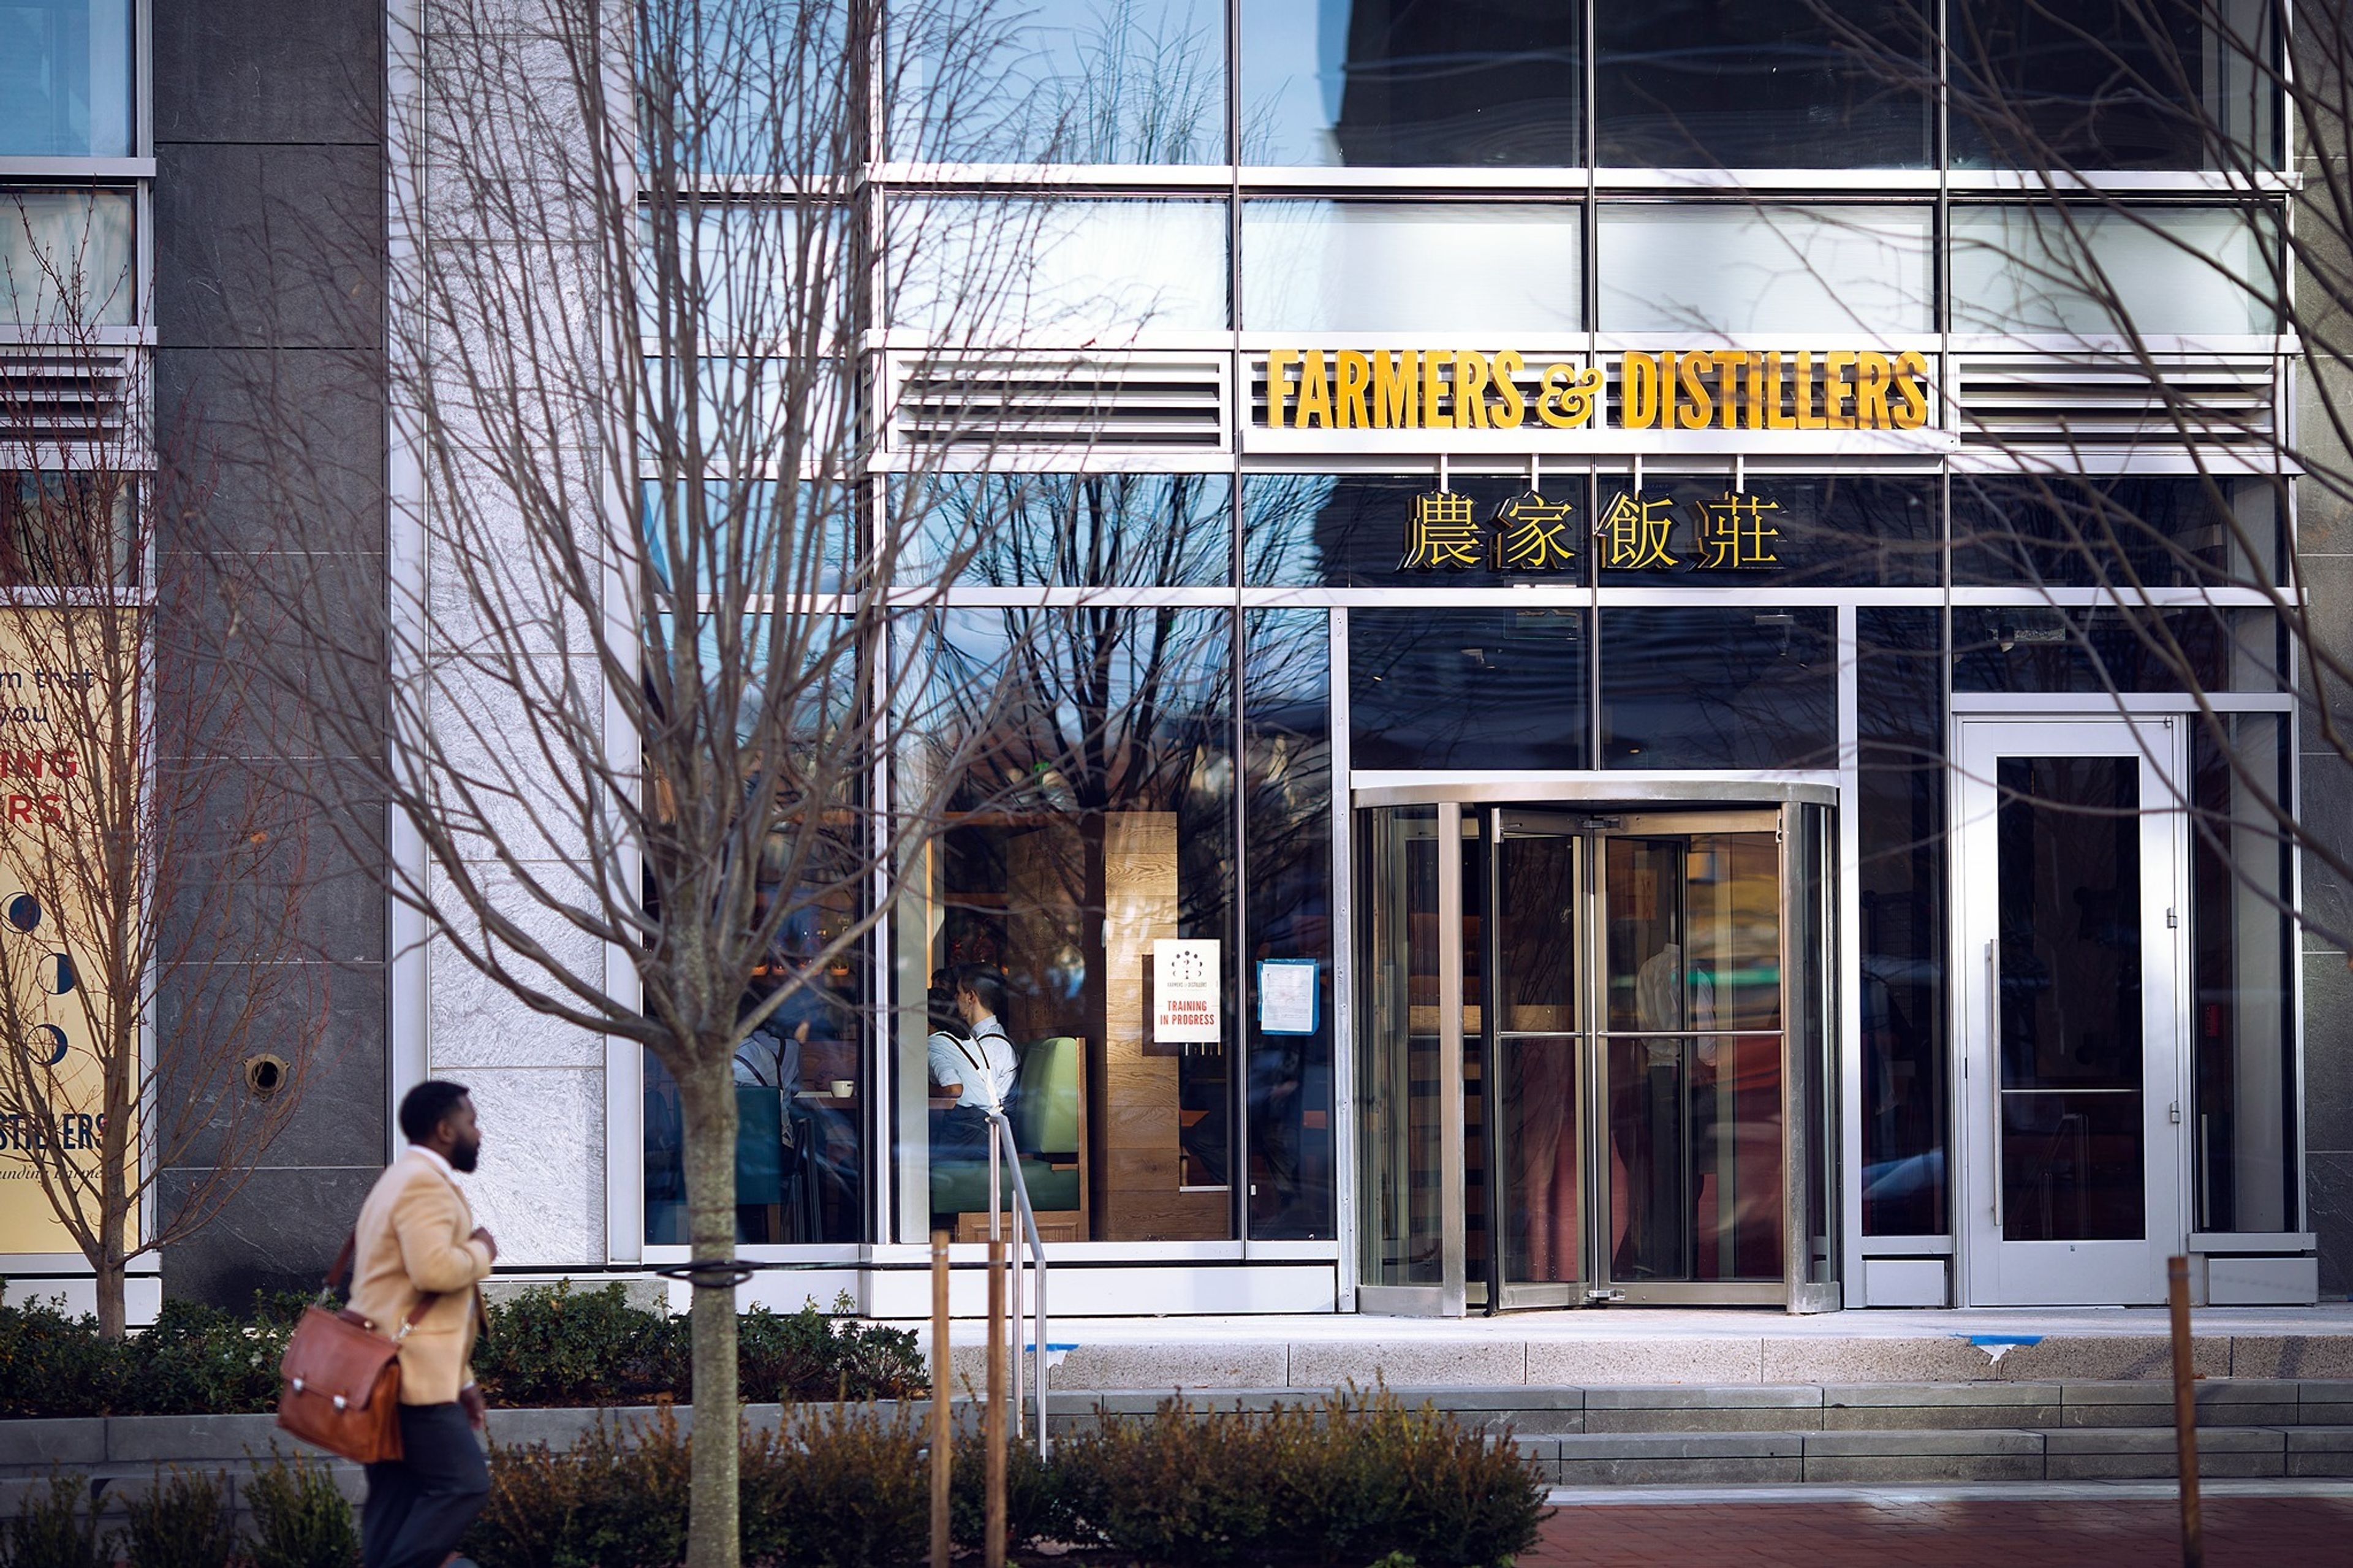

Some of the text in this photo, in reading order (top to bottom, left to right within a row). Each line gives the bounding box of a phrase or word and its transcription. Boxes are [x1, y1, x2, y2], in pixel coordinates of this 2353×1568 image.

[1268, 349, 1928, 430] FARMERS & DISTILLERS
[1412, 492, 1779, 568] 農家飯莊
[0, 795, 61, 823] RS
[1160, 1014, 1214, 1025] IN PROGRESS
[1167, 1000, 1207, 1011] TRAINING
